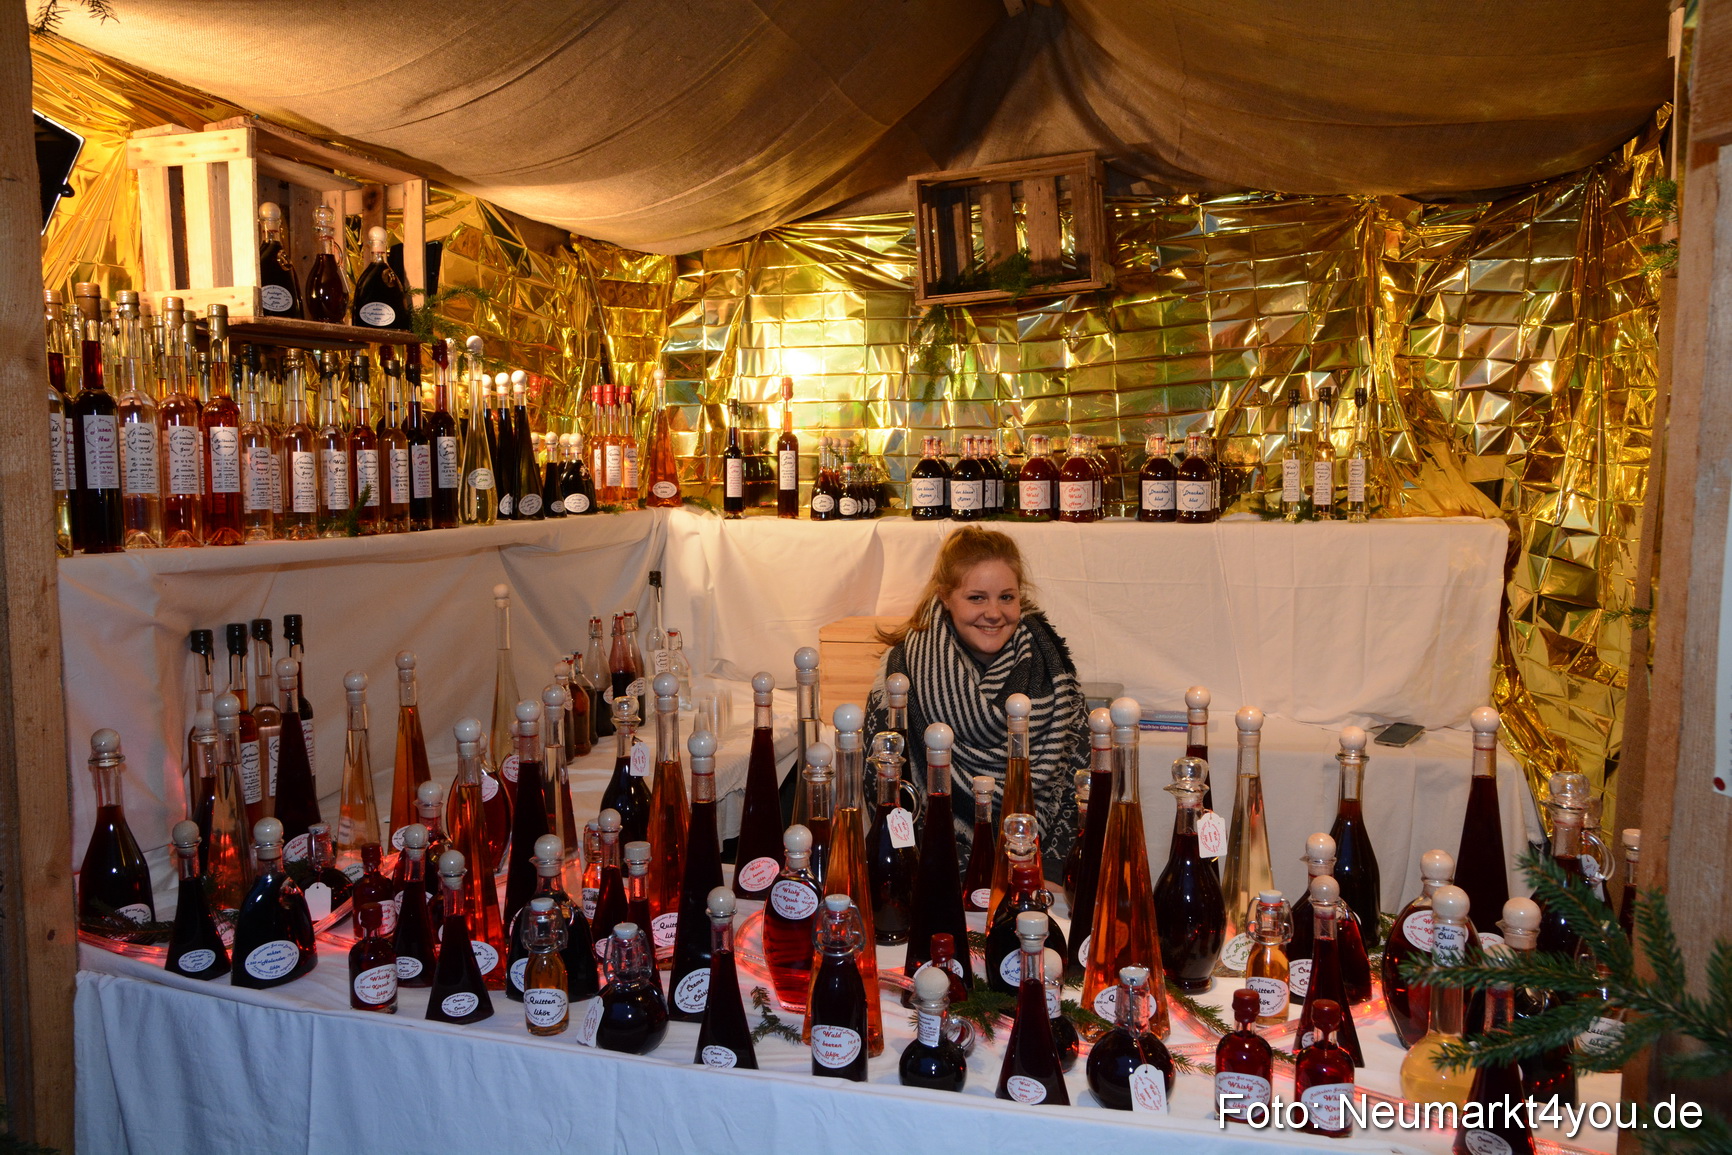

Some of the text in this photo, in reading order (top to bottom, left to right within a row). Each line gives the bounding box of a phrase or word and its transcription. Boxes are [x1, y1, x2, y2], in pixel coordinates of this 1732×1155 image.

[783, 886, 800, 897] Whisky
[1437, 932, 1455, 940] Chili
[370, 973, 391, 982] Whisky
[530, 996, 557, 1005] Quitten
[822, 1030, 842, 1038] Wald
[1227, 1080, 1254, 1092] Whisky
